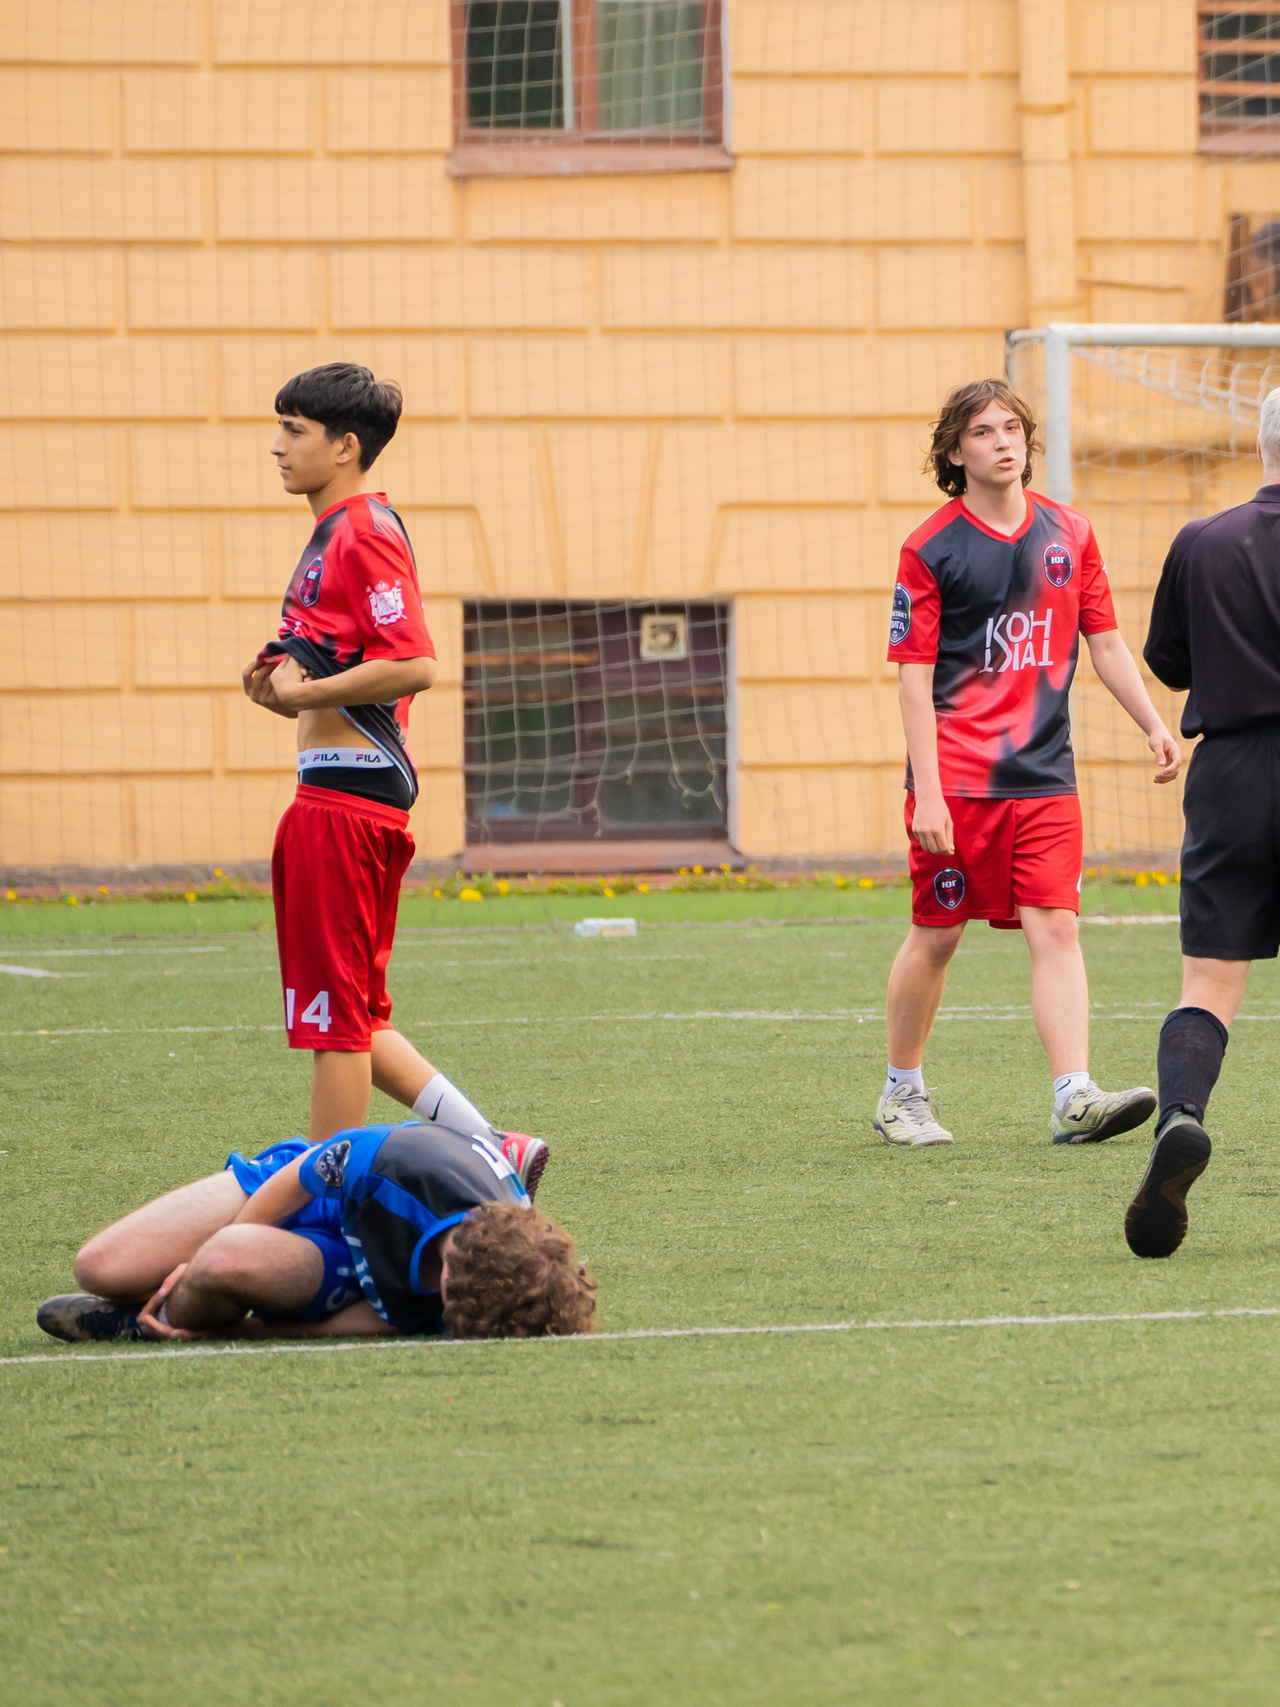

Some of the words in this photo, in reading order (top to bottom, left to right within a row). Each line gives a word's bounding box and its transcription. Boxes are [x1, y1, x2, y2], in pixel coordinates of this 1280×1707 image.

[1050, 556, 1066, 564] ЮГ
[313, 753, 340, 762] FILA
[356, 753, 381, 763] FILA
[941, 880, 957, 889] ЮГ
[286, 988, 332, 1033] 14
